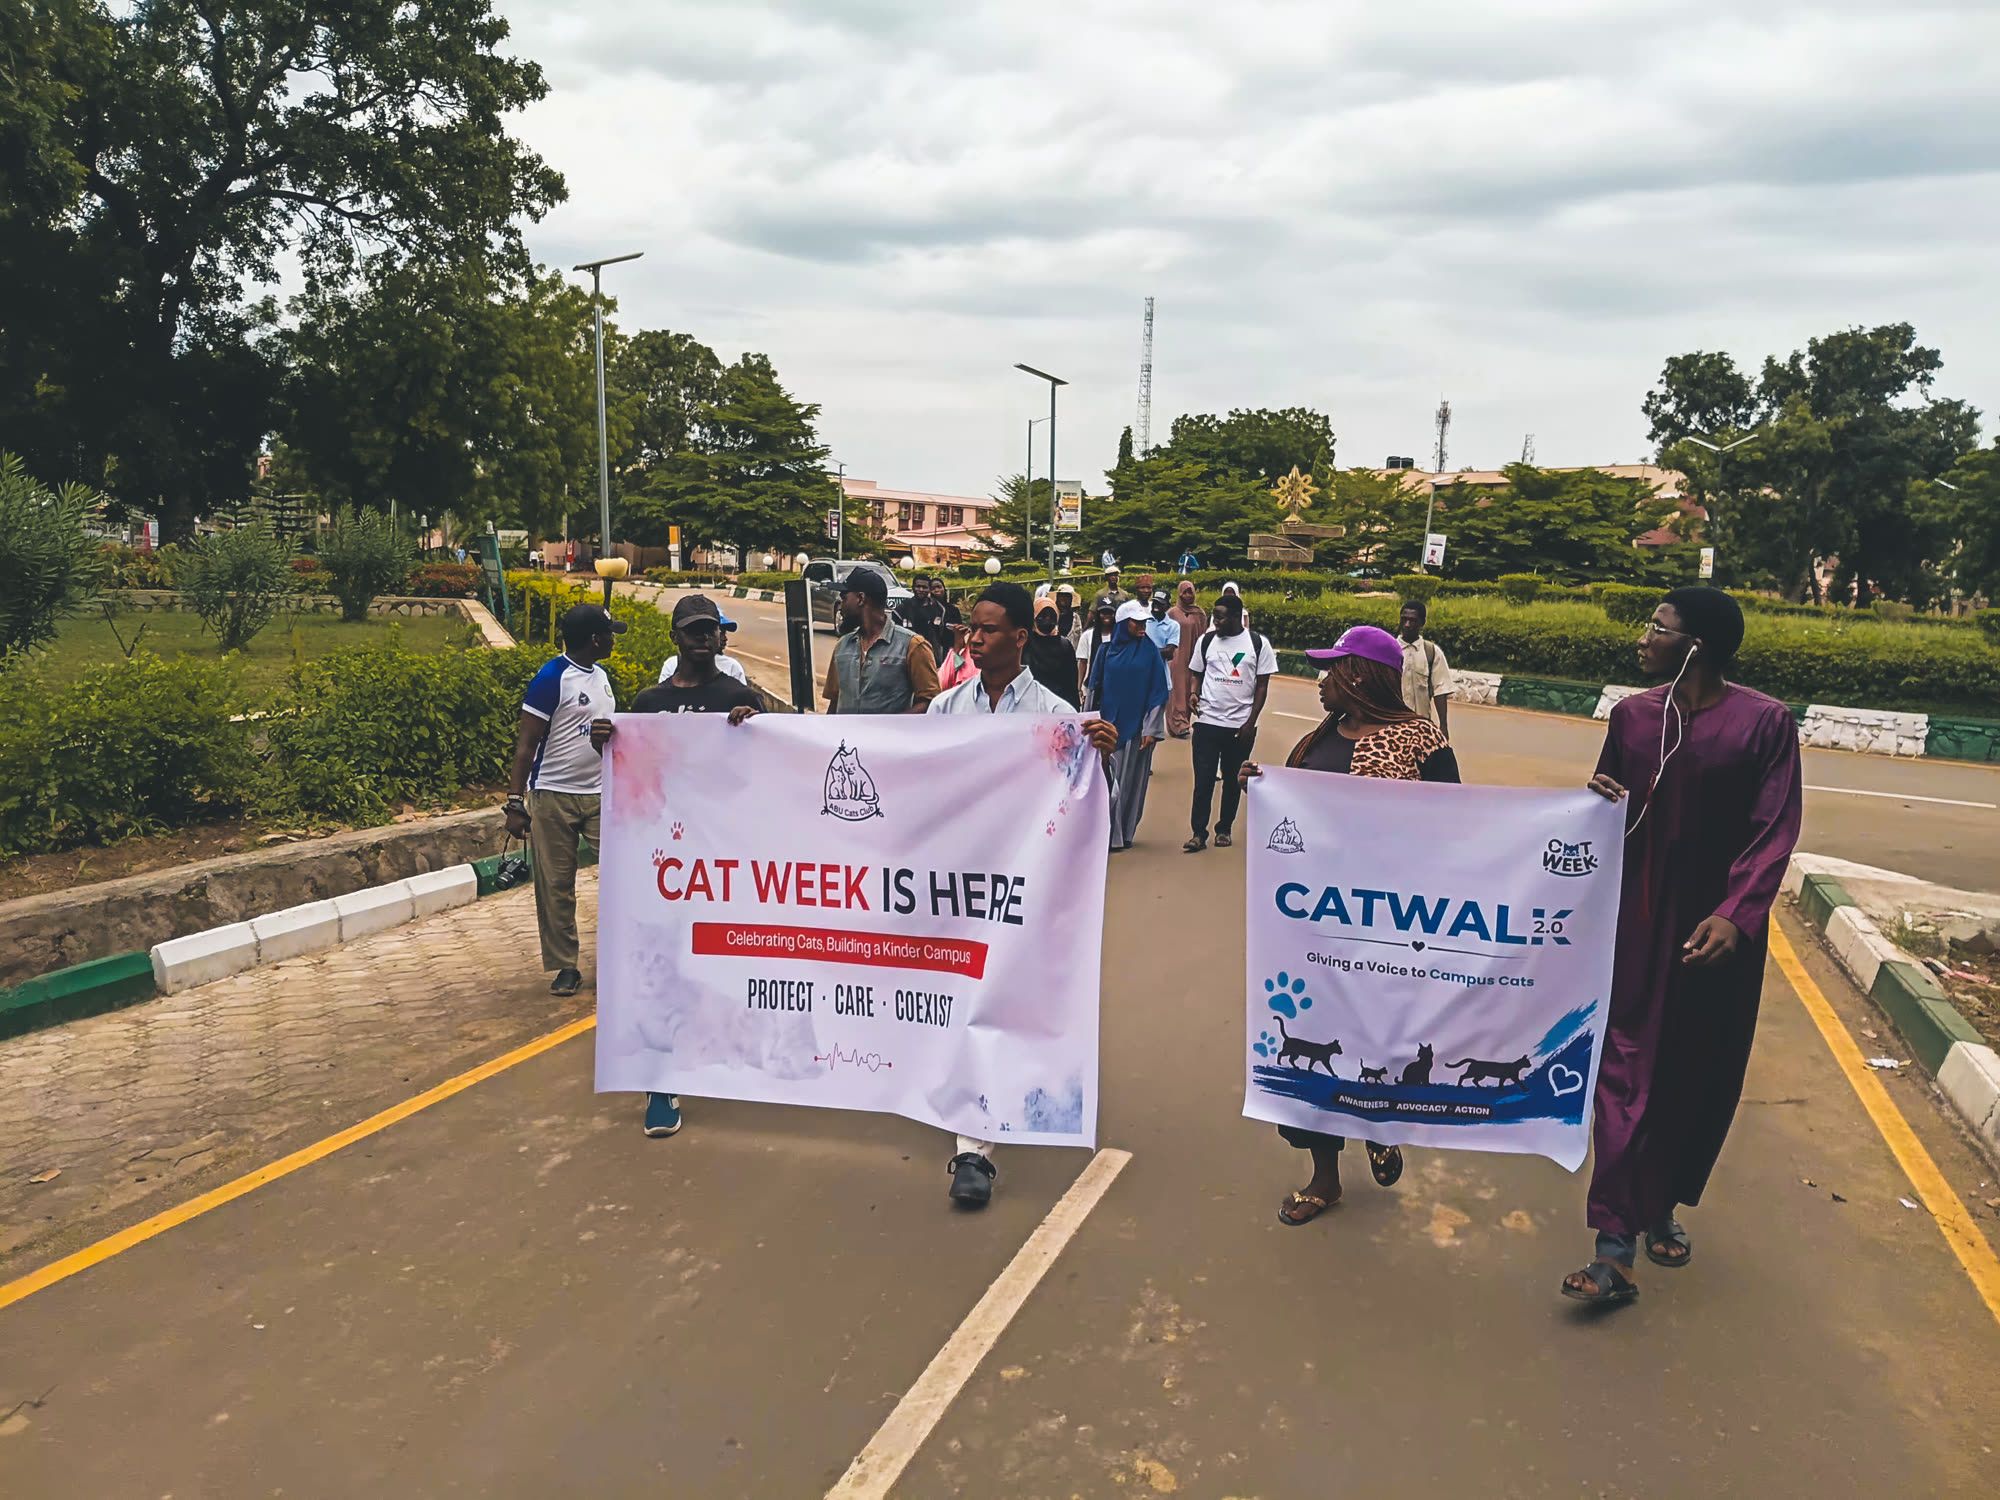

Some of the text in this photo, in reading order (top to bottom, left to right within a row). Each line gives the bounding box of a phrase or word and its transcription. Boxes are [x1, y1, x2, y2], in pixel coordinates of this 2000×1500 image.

[845, 809, 858, 817] Cats
[860, 806, 874, 816] Club
[1543, 851, 1598, 872] WEEK
[657, 857, 1025, 925] CAT WEEK IS HERE
[1274, 882, 1574, 946] CATWALK 2.0
[726, 930, 971, 964] Celebrating Cats, Building a Kinder Campus
[1306, 952, 1535, 987] Giving a Voice to Campus Cats
[748, 978, 953, 1029] PROTECT CARE COEXIST
[1339, 1094, 1490, 1116] AWARENESS ADVOCACY ACTION
